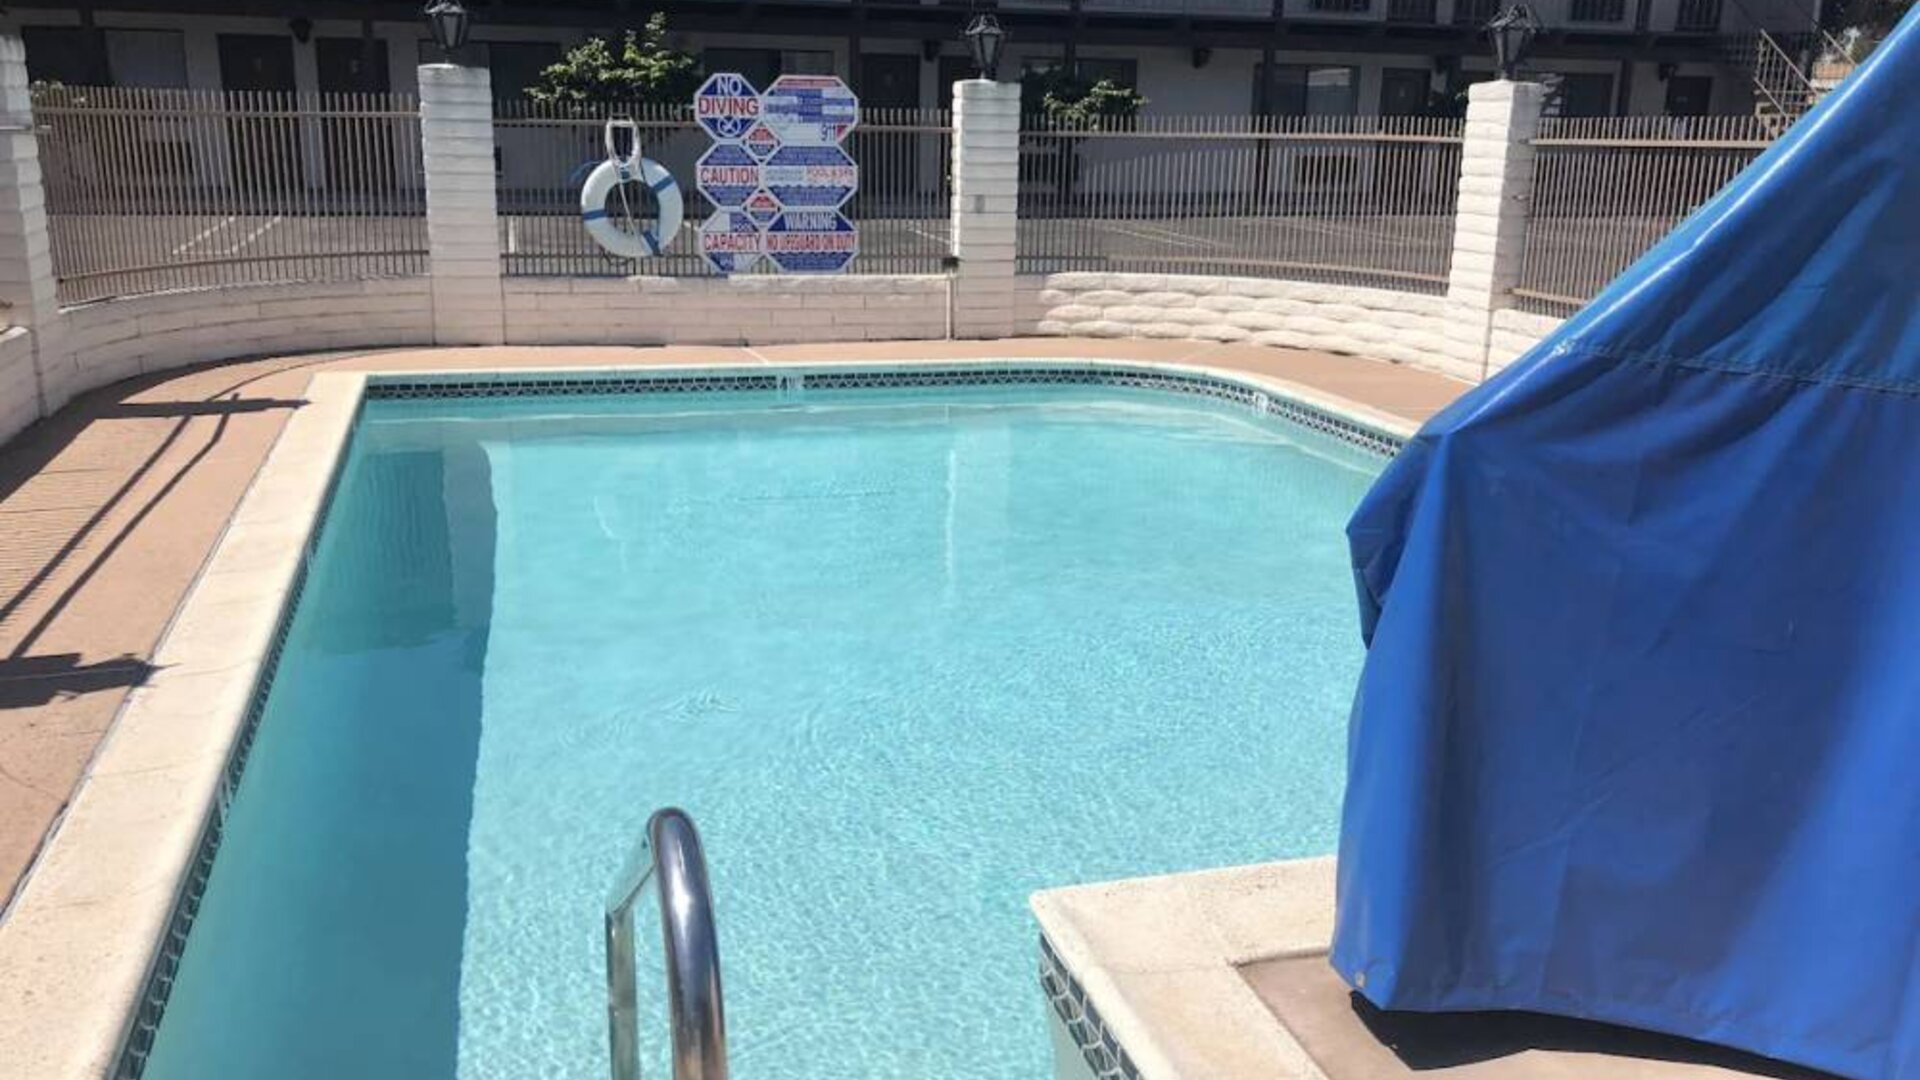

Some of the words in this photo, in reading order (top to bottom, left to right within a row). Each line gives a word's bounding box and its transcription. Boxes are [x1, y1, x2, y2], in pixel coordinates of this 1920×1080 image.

[717, 77, 742, 95] NO
[698, 98, 759, 115] DIVING
[820, 125, 836, 142] 911
[701, 168, 759, 183] CAUTION
[784, 213, 838, 229] WARNING
[704, 234, 760, 251] CAPACITY
[767, 234, 778, 250] NO
[822, 234, 834, 250] ON
[836, 234, 856, 250] DUTY
